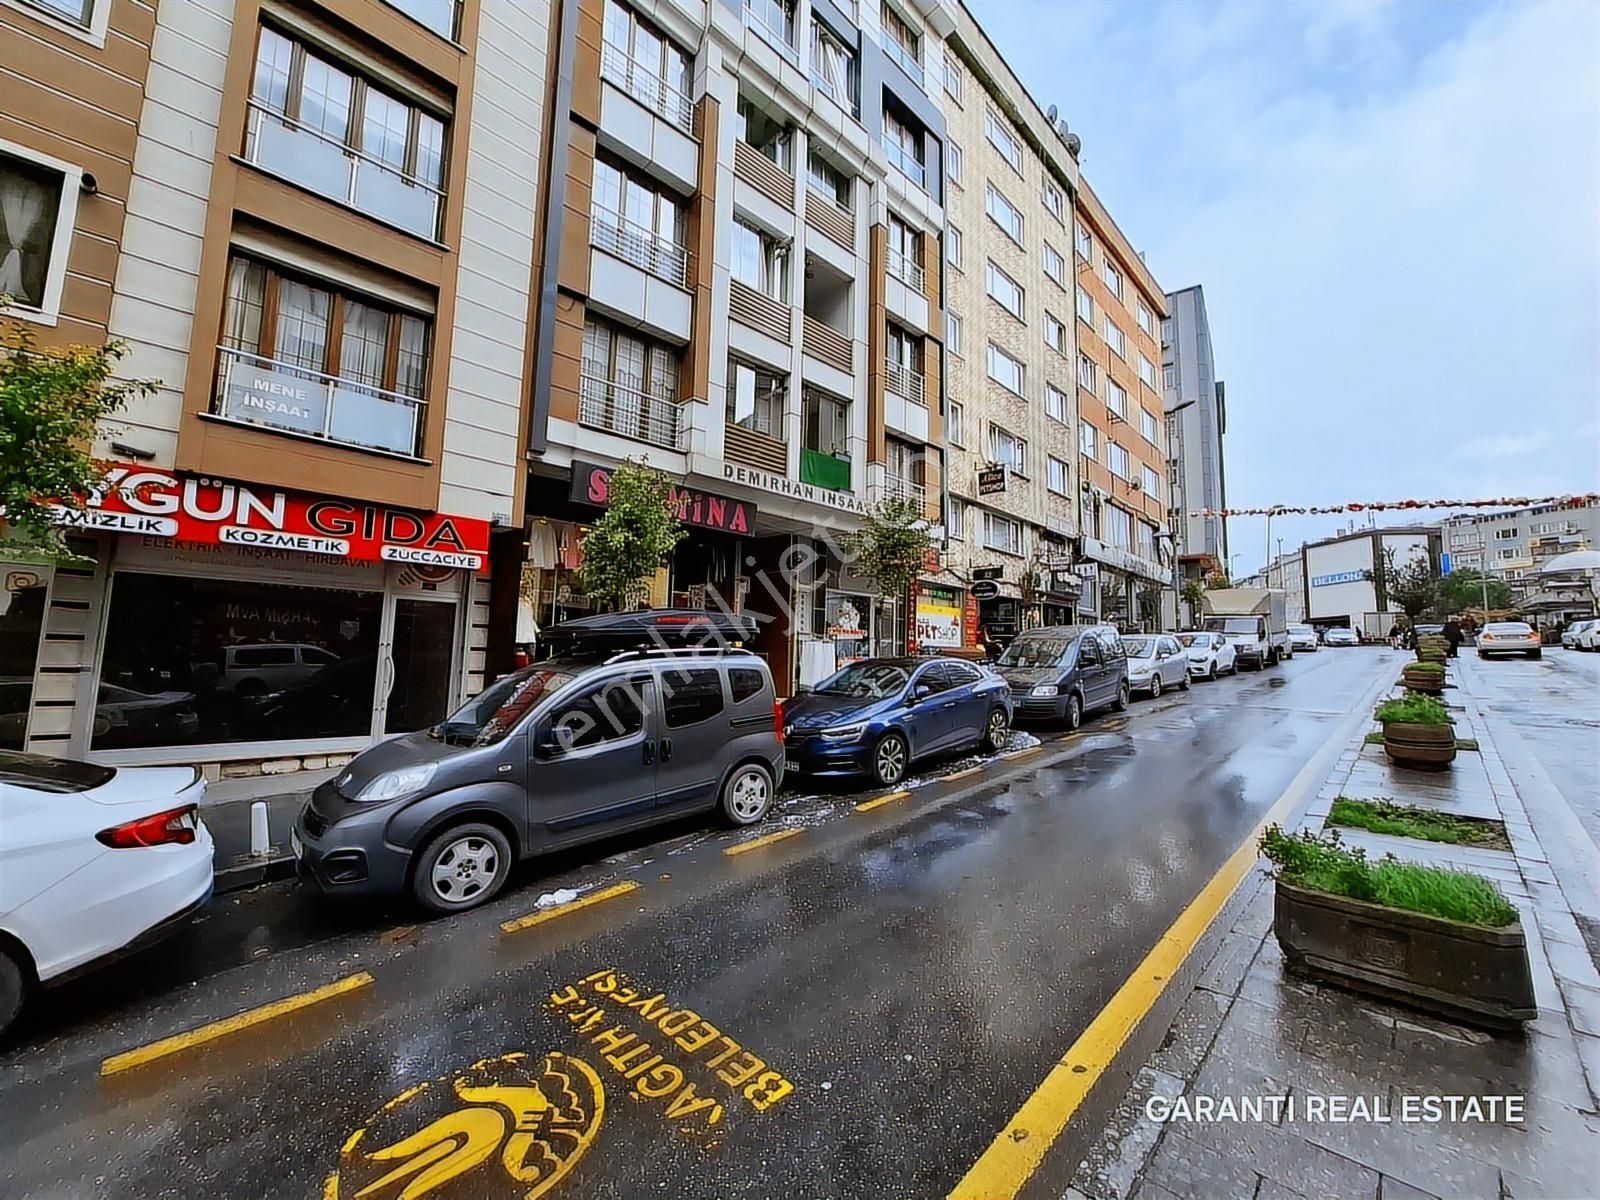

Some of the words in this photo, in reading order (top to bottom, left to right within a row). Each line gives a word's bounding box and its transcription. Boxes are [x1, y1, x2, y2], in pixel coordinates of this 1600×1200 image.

[253, 379, 306, 400] MENE
[86, 466, 286, 531] YGÜN
[306, 500, 467, 551] GIDA
[588, 468, 748, 532] SMİNA
[48, 506, 163, 533] EMİZLİK
[225, 528, 343, 553] KOZMETİK
